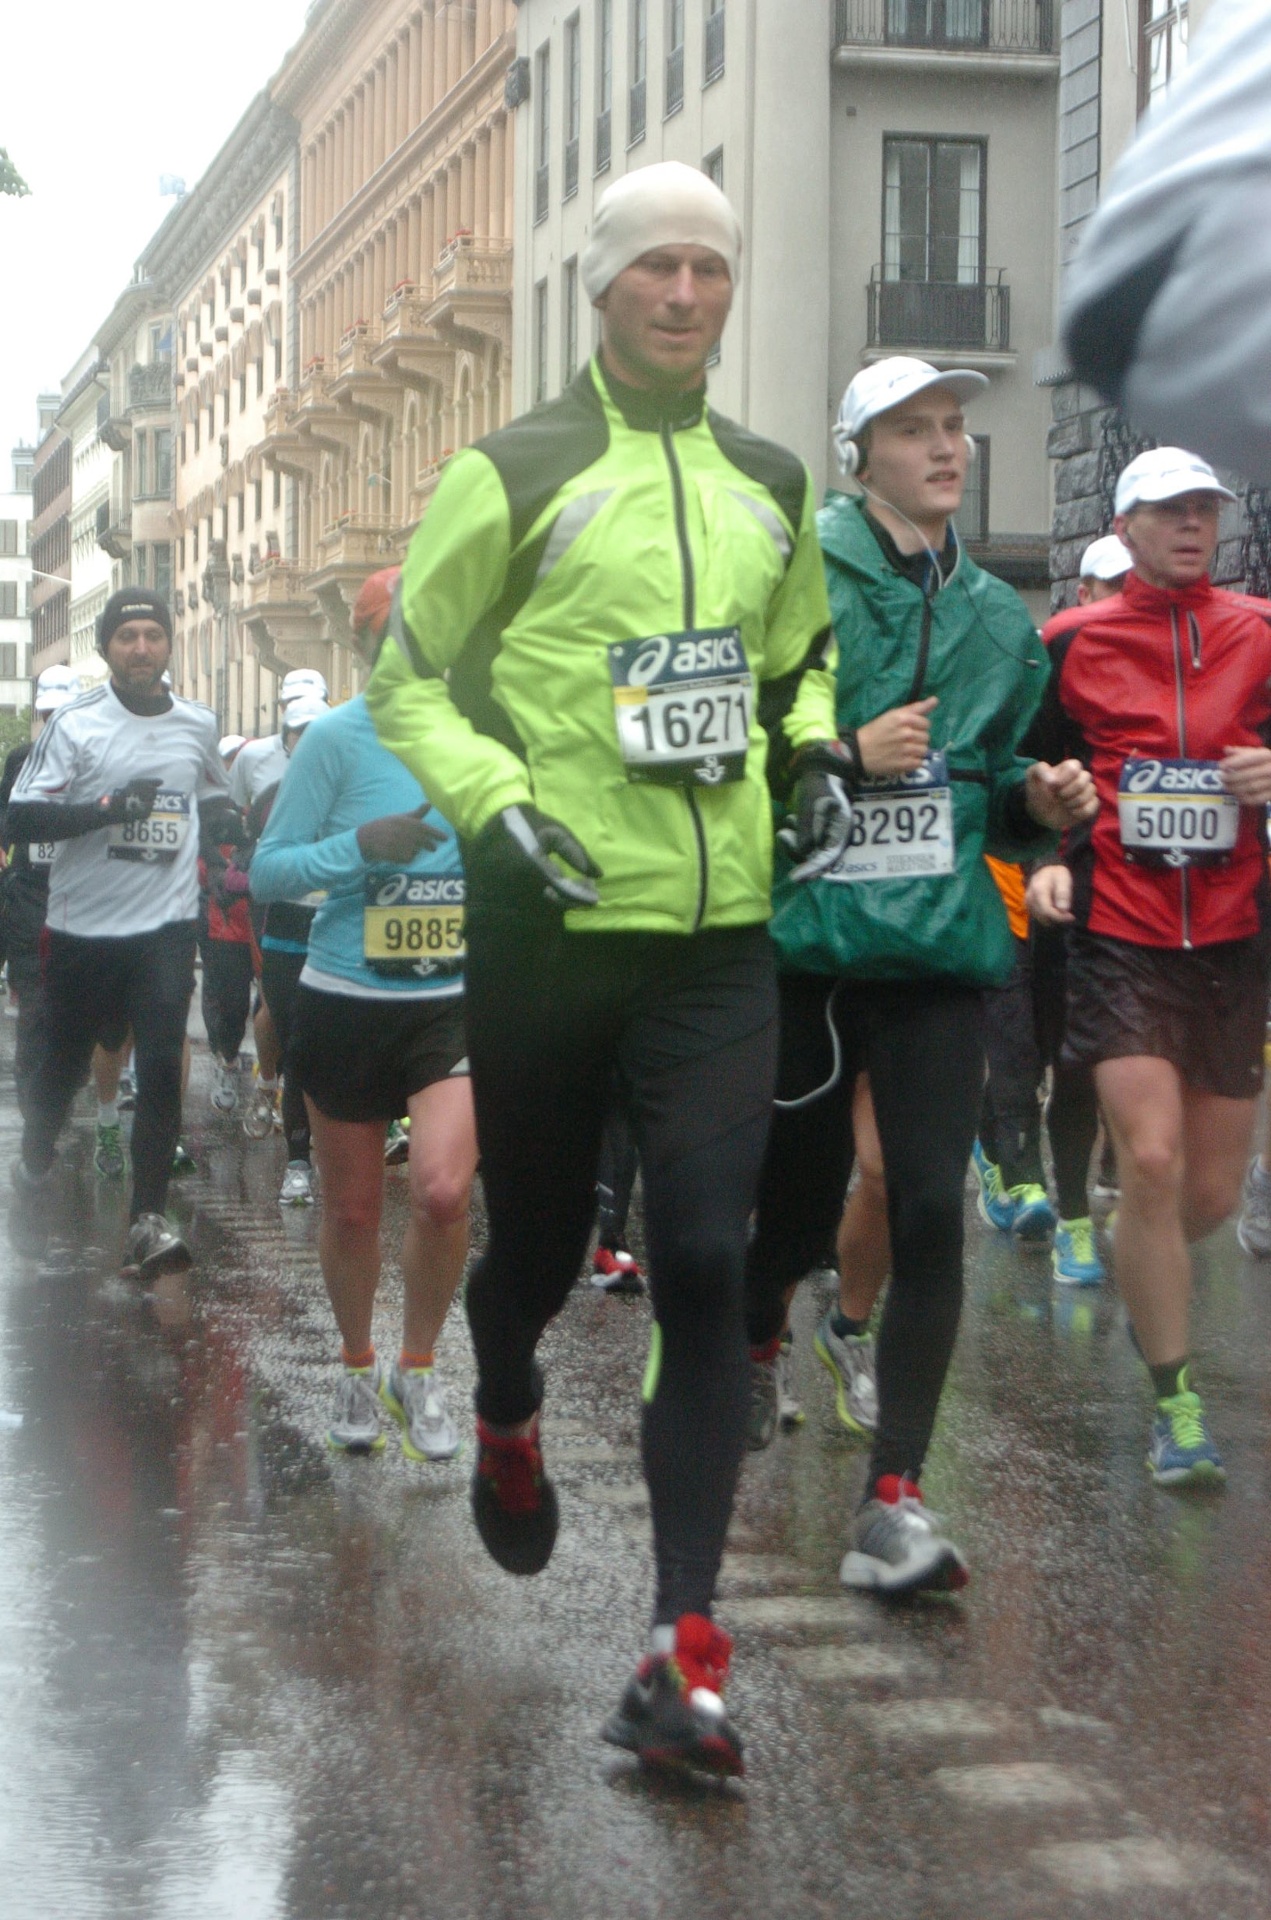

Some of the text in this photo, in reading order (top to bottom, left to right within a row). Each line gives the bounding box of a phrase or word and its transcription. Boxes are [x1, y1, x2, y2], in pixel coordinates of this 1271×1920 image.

[672, 637, 740, 673] asics
[631, 692, 749, 751] 16271
[1160, 767, 1224, 790] asics
[123, 820, 178, 844] 8655
[850, 803, 940, 847] 8292
[1137, 807, 1219, 840] 5000
[407, 879, 465, 901] asics
[385, 917, 463, 950] 9885
